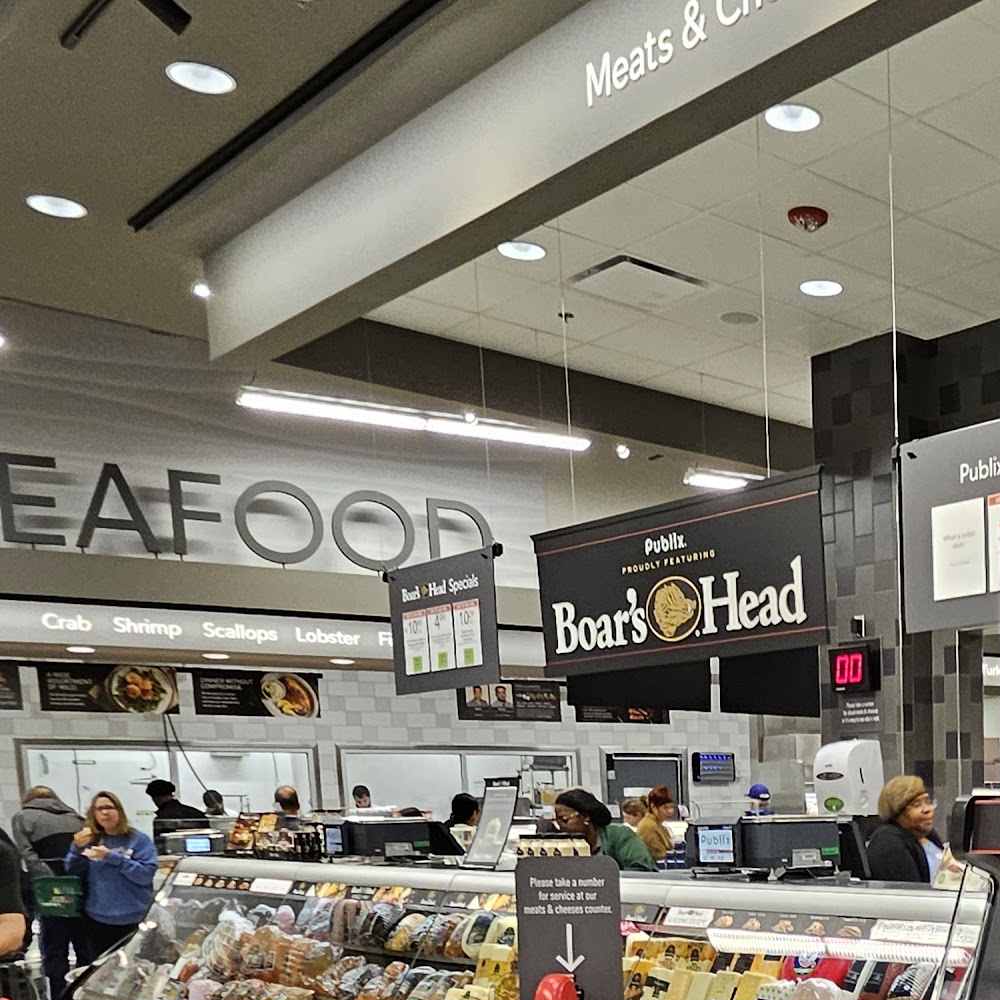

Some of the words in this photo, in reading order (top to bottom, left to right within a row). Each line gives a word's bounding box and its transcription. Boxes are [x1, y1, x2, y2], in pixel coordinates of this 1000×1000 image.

[585, 28, 674, 107] Meats
[682, 0, 708, 49] &
[645, 532, 687, 556] Publix
[622, 558, 661, 575] PROUDLY
[664, 549, 716, 569] FEATURING
[428, 580, 446, 597] Head
[448, 573, 479, 595] Specials
[552, 587, 647, 655] Boar's
[700, 555, 807, 635] Head
[42, 612, 92, 634] Crab
[113, 617, 182, 639] Shrimp
[202, 621, 278, 643] Scallops
[296, 627, 360, 647] Lobster
[836, 653, 862, 685] 00
[701, 835, 730, 845] Publix
[530, 877, 553, 888] Please
[555, 878, 570, 888] take
[572, 880, 576, 888] a
[578, 877, 605, 888] number
[539, 891, 548, 901] for
[550, 892, 575, 901] service
[576, 892, 584, 900] at
[586, 893, 597, 901] our
[524, 905, 546, 915] meats
[547, 905, 553, 914] &
[555, 904, 583, 914] cheeses
[585, 905, 613, 914] counter.
